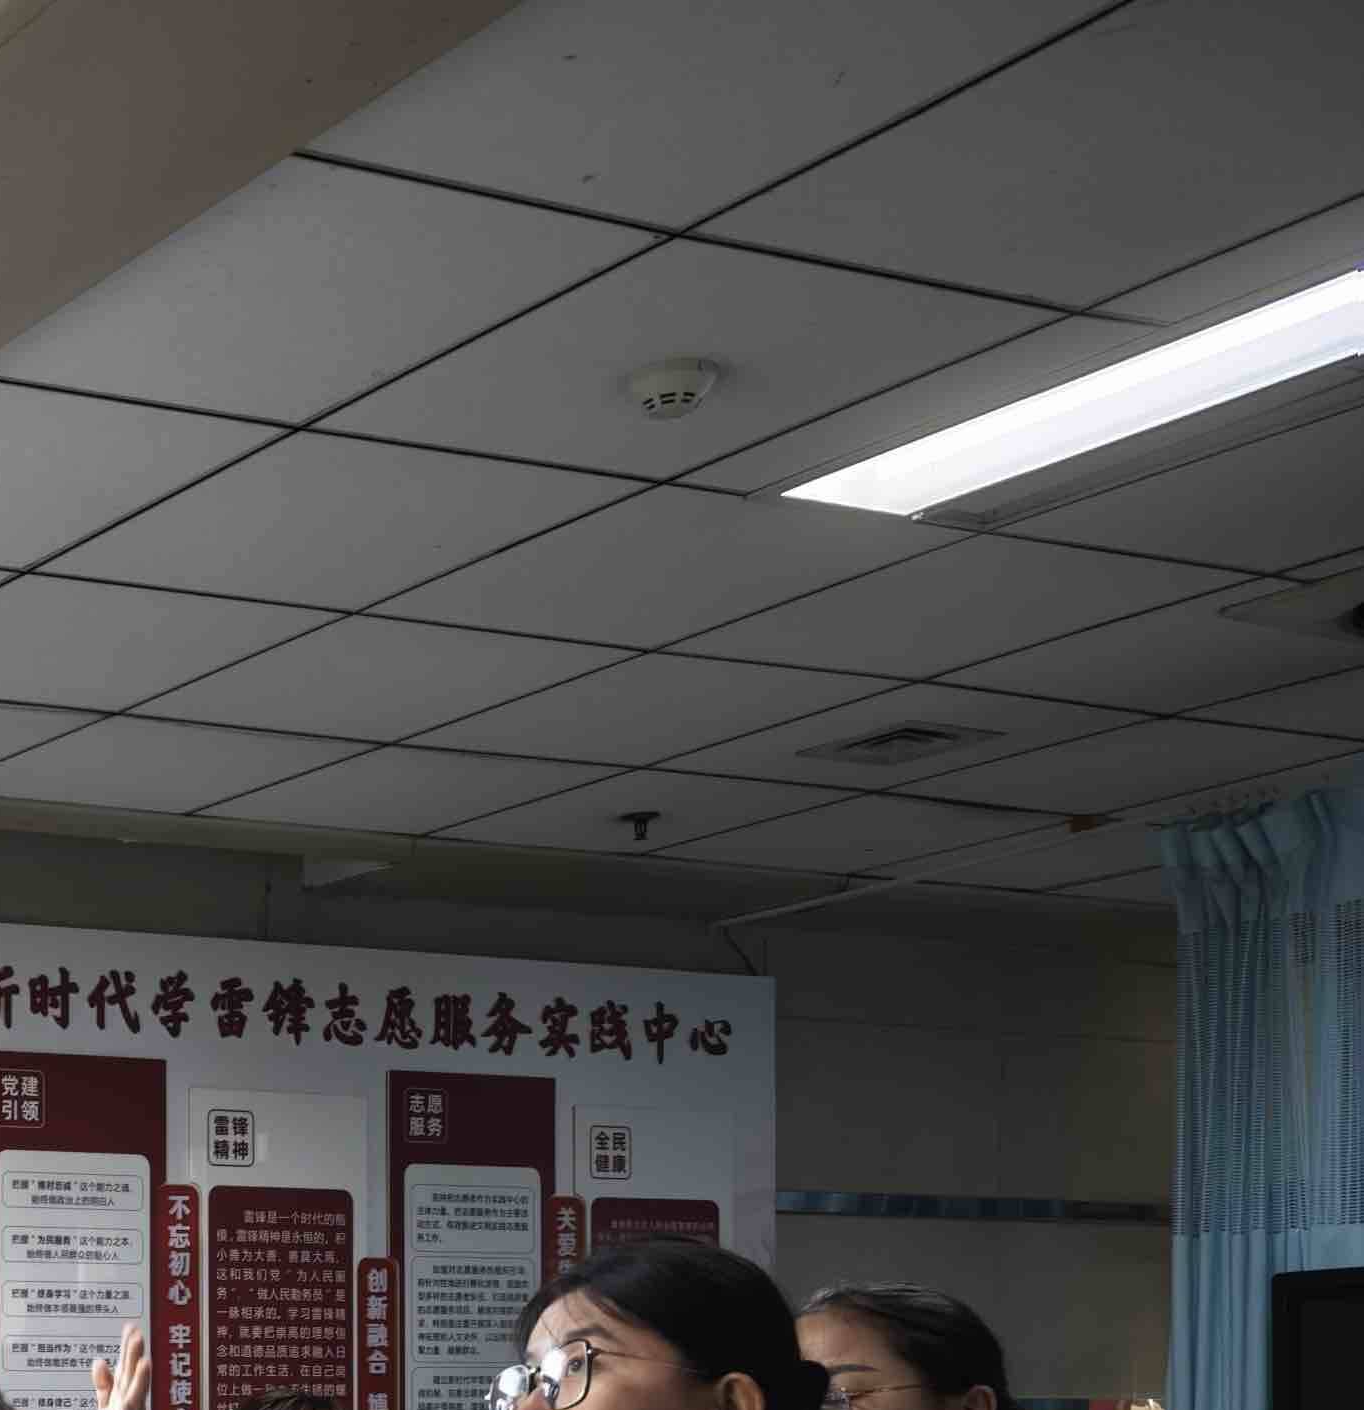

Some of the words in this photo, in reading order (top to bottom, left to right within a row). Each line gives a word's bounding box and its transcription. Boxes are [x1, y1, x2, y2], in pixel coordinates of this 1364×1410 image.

[0, 1073, 40, 1098] 党建
[0, 1099, 42, 1124] 引领
[408, 1093, 443, 1115] 志愿
[212, 1114, 249, 1138] 雷锋
[408, 1116, 444, 1139] 服务
[212, 1138, 249, 1162] 精神
[595, 1131, 626, 1151] 全民
[595, 1153, 627, 1173] 健康
[168, 1194, 192, 1306] 不忘初心
[366, 1268, 389, 1375] 创新融合
